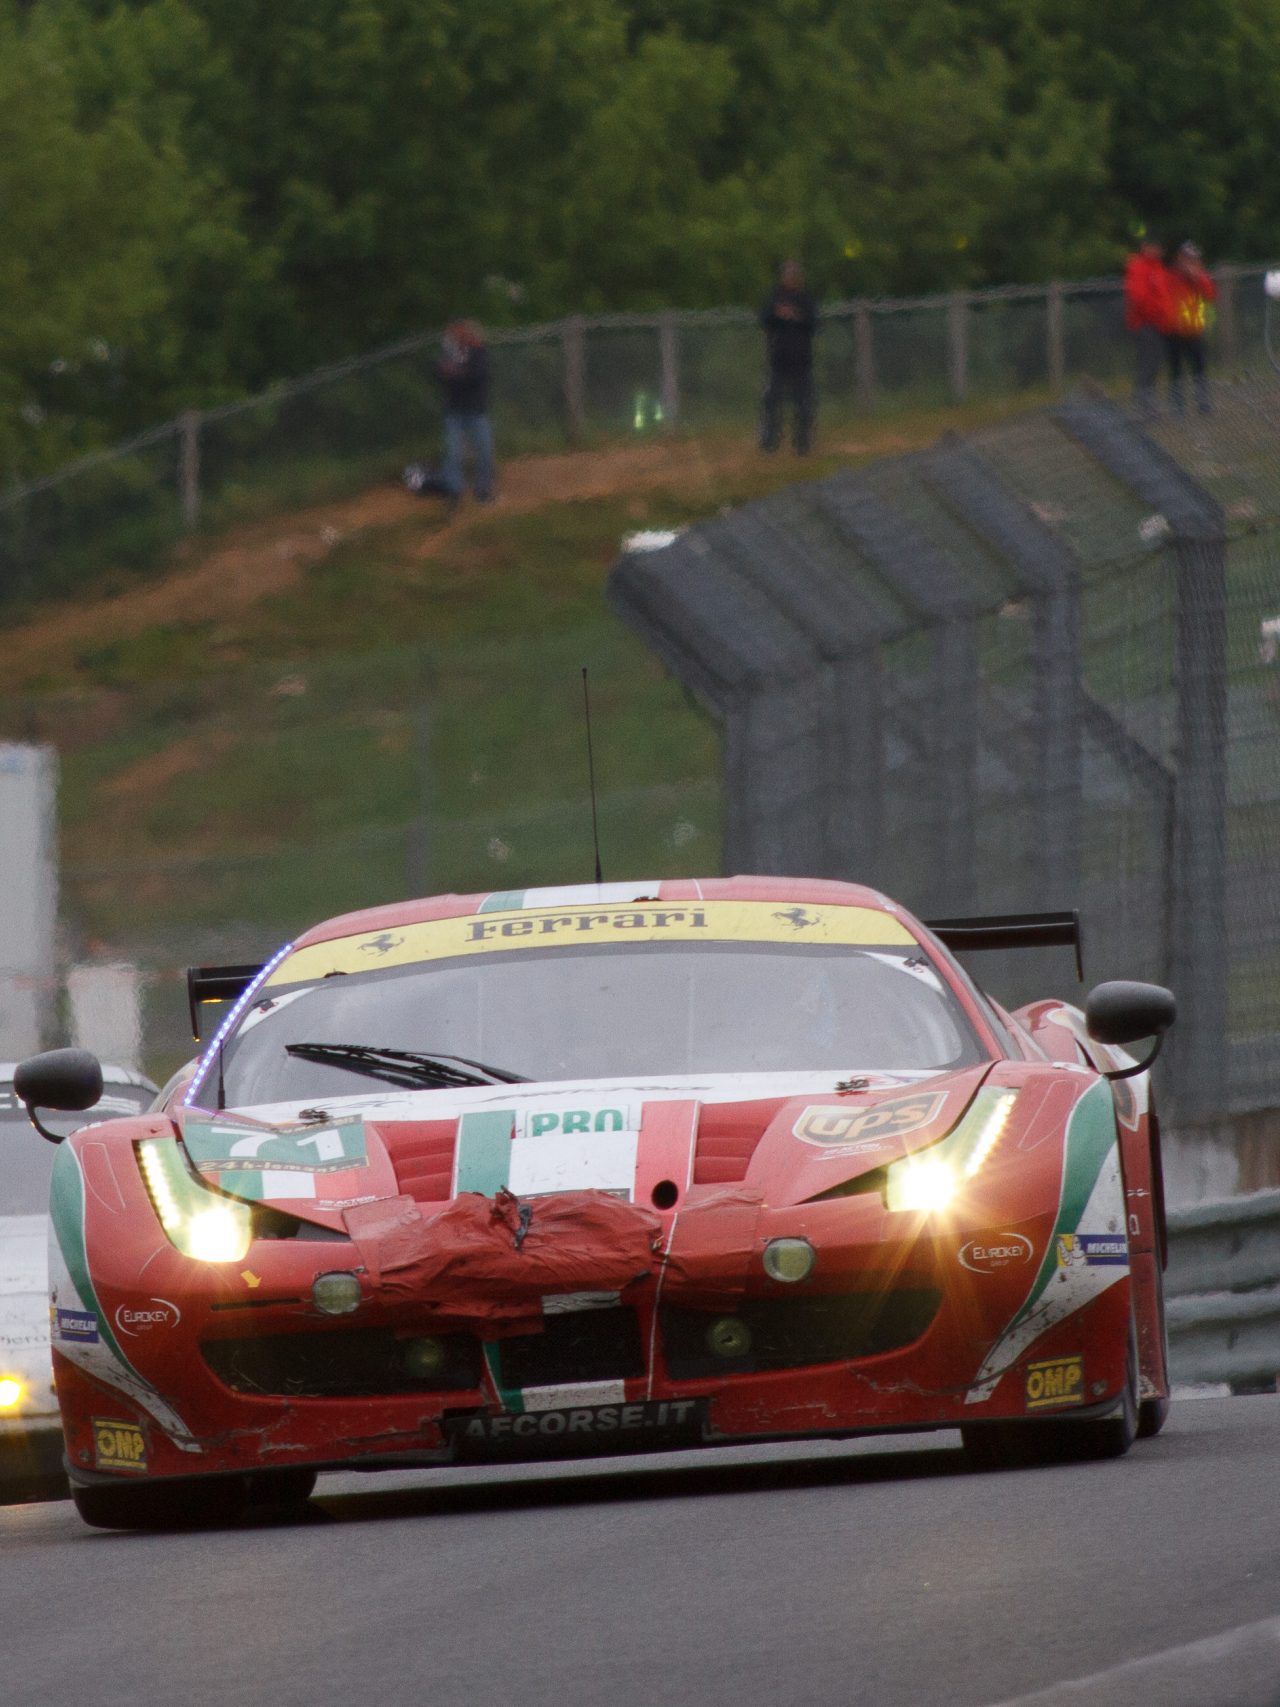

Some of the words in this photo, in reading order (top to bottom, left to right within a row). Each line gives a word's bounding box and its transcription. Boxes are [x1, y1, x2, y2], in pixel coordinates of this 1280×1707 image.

[464, 908, 708, 942] Ferrari
[532, 1109, 624, 1137] PRO
[807, 1103, 930, 1139] ups
[210, 1127, 345, 1161] 71
[1087, 1242, 1127, 1255] MICHELIN
[60, 1318, 98, 1332] MICHELIN
[123, 1310, 170, 1323] EUROKEY
[1027, 1364, 1082, 1399] OMP
[97, 1429, 145, 1460] OMP
